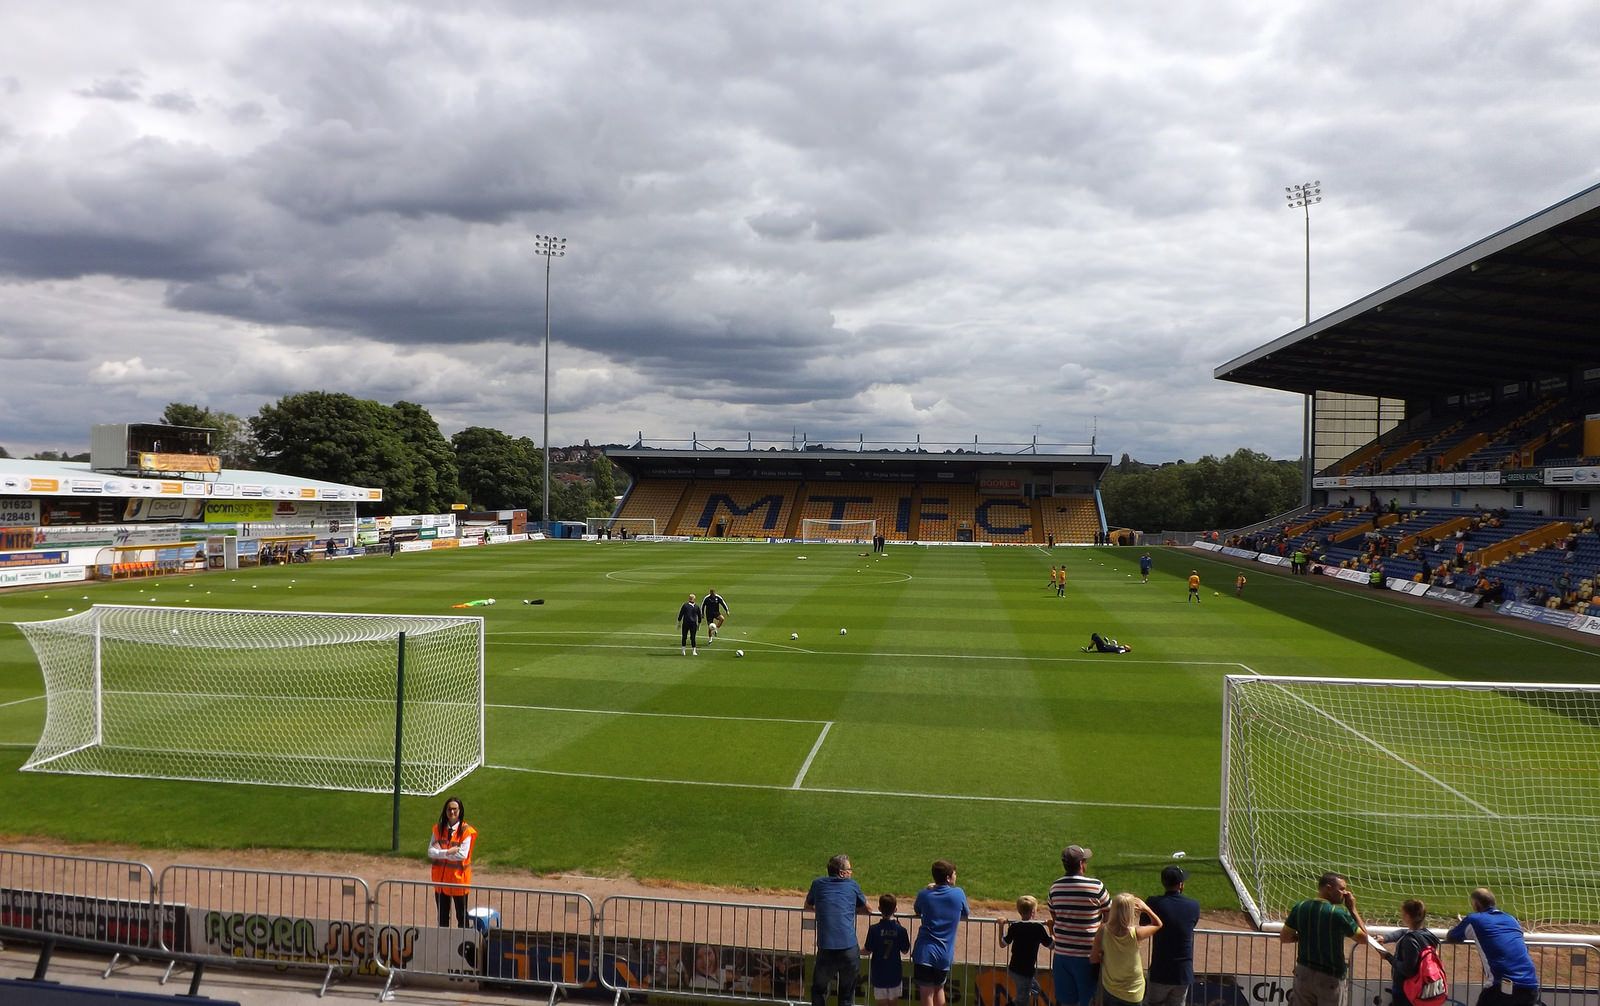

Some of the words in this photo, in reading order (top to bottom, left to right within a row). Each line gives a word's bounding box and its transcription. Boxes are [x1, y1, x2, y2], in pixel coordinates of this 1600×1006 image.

[980, 480, 1017, 488] BOOKER
[2, 501, 32, 509] 01623
[0, 512, 35, 521] 428481
[14, 894, 37, 909] and
[40, 896, 84, 915] design
[47, 914, 95, 936] Design
[205, 911, 320, 958] ACORN
[883, 940, 894, 960] 7
